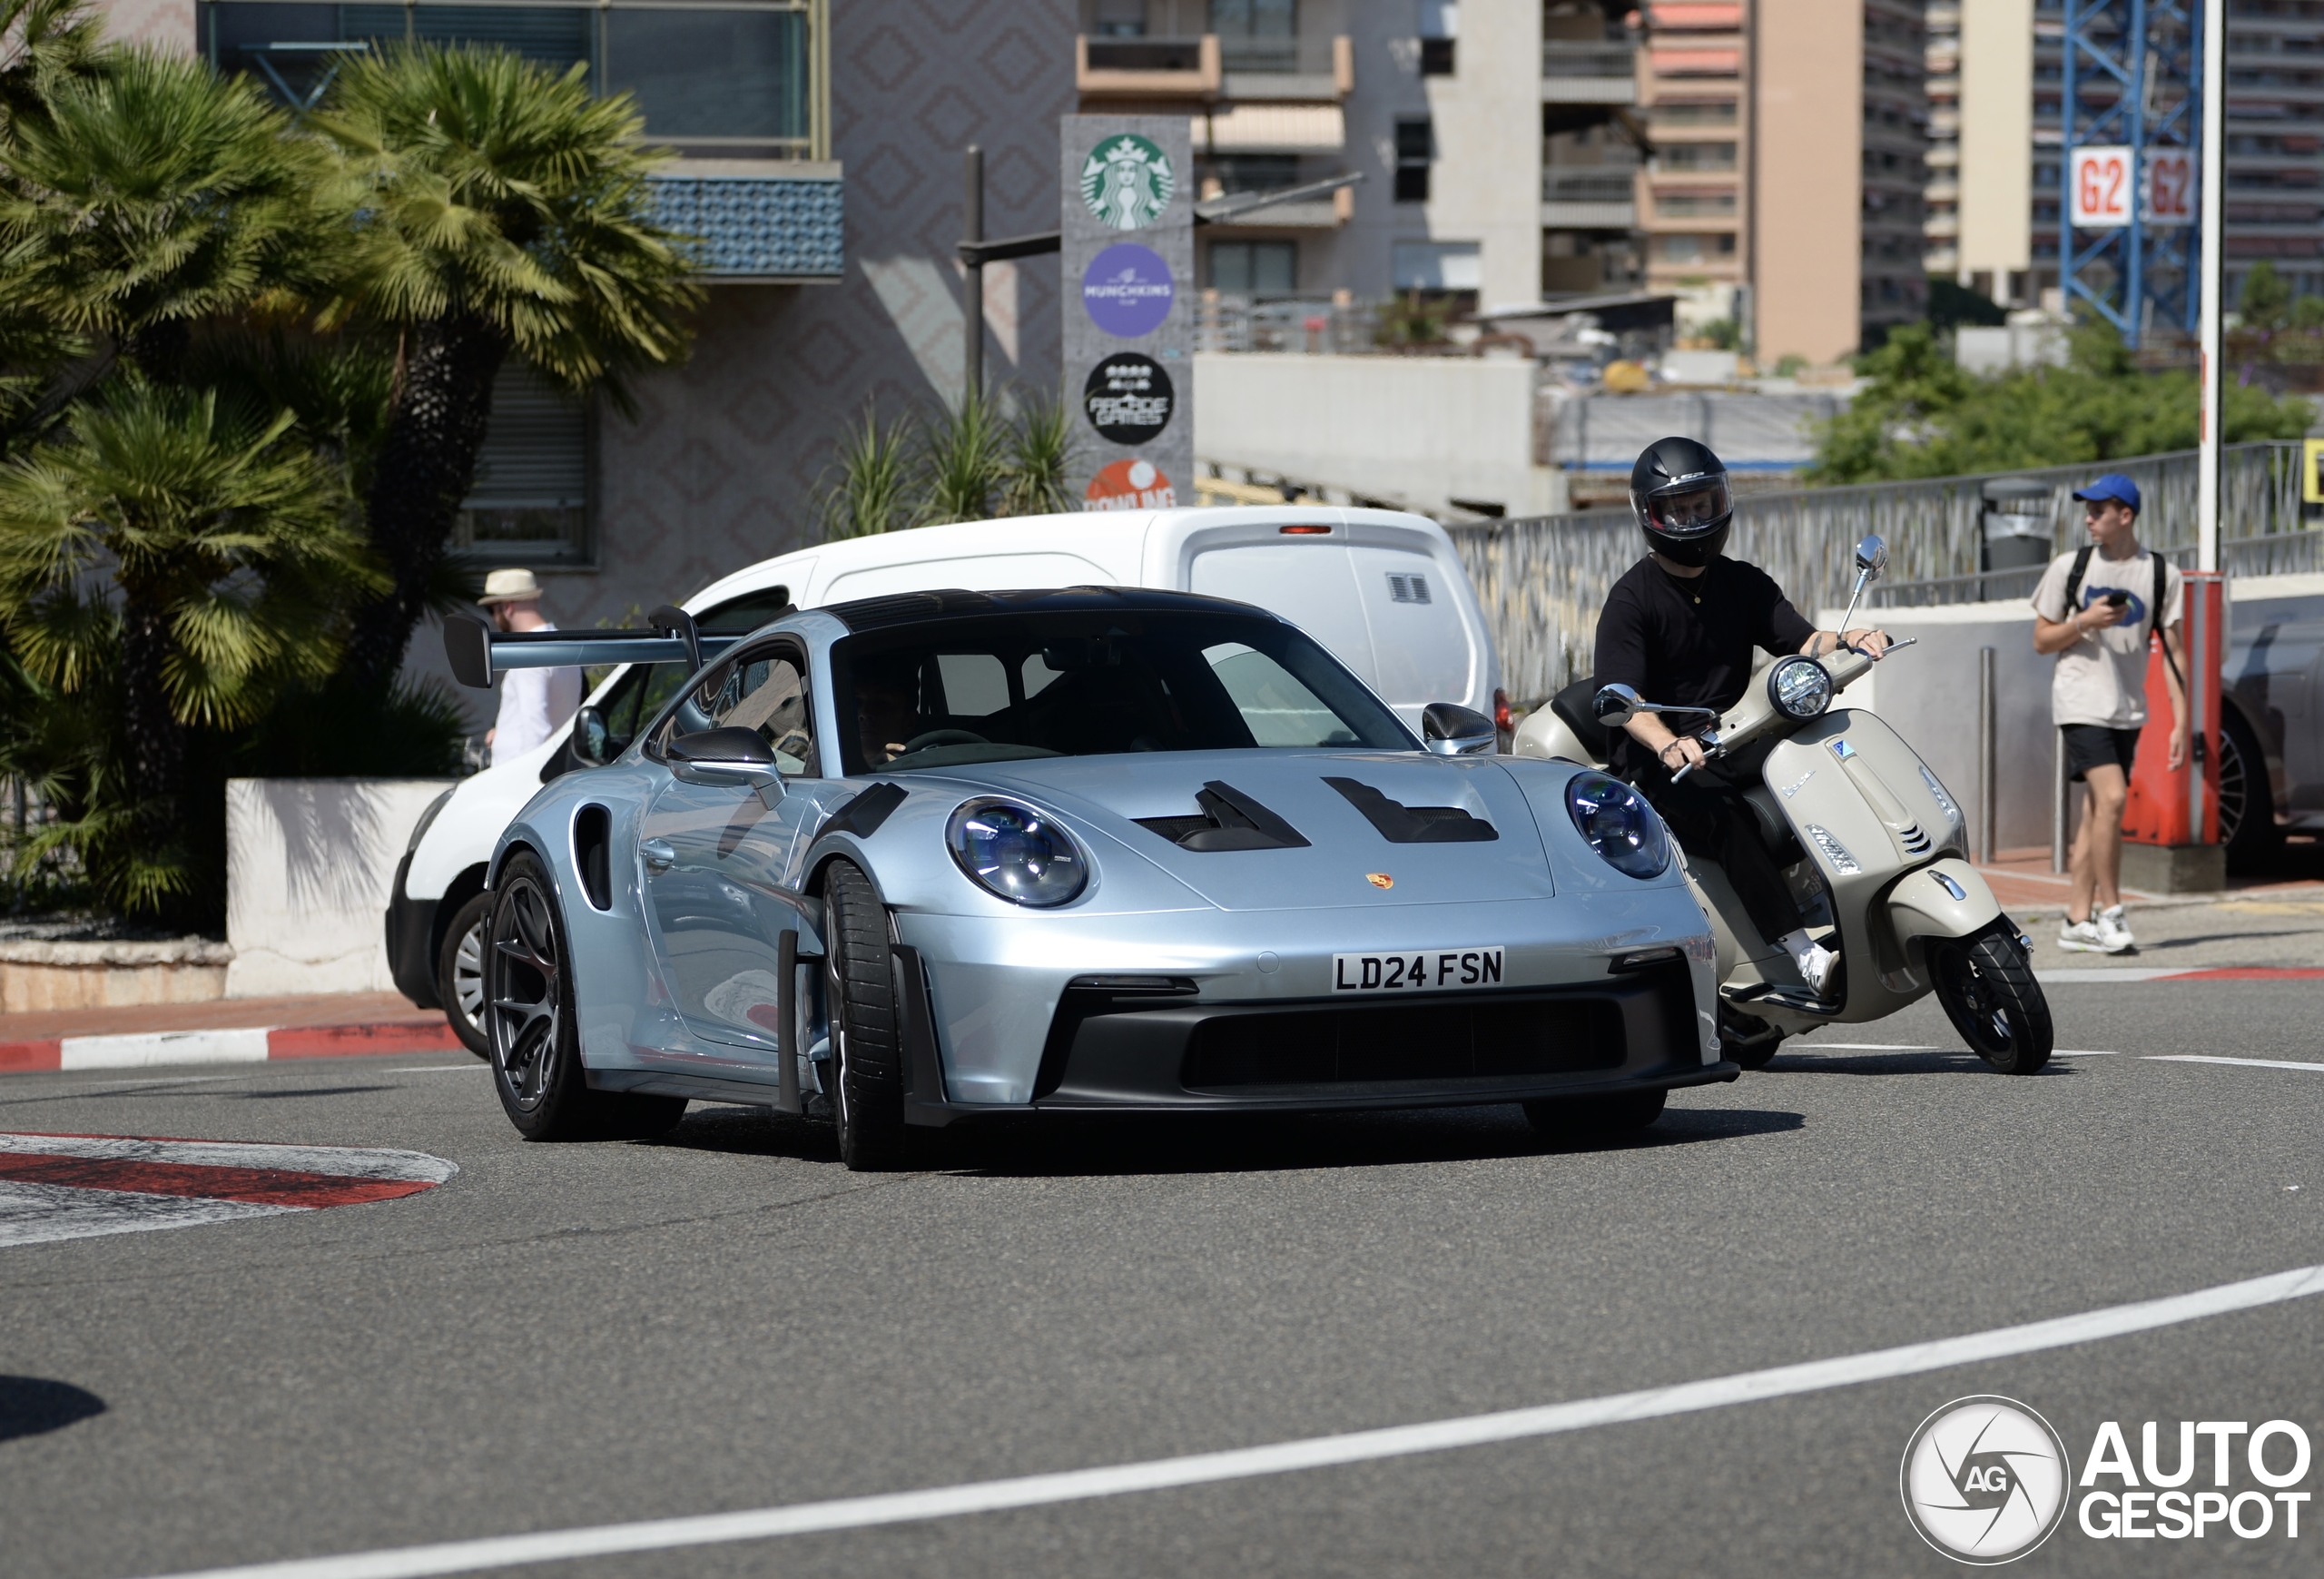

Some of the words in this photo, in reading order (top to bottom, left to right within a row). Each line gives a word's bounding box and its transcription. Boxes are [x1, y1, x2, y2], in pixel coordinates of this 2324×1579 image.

[2080, 158, 2123, 214] G2
[2152, 158, 2189, 214] G2
[1085, 284, 1171, 299] MUNCHKINS
[1090, 397, 1169, 412] ARCADE
[1096, 410, 1163, 426] GAMES
[1336, 956, 1426, 990] LD24
[1437, 951, 1502, 986] FSN
